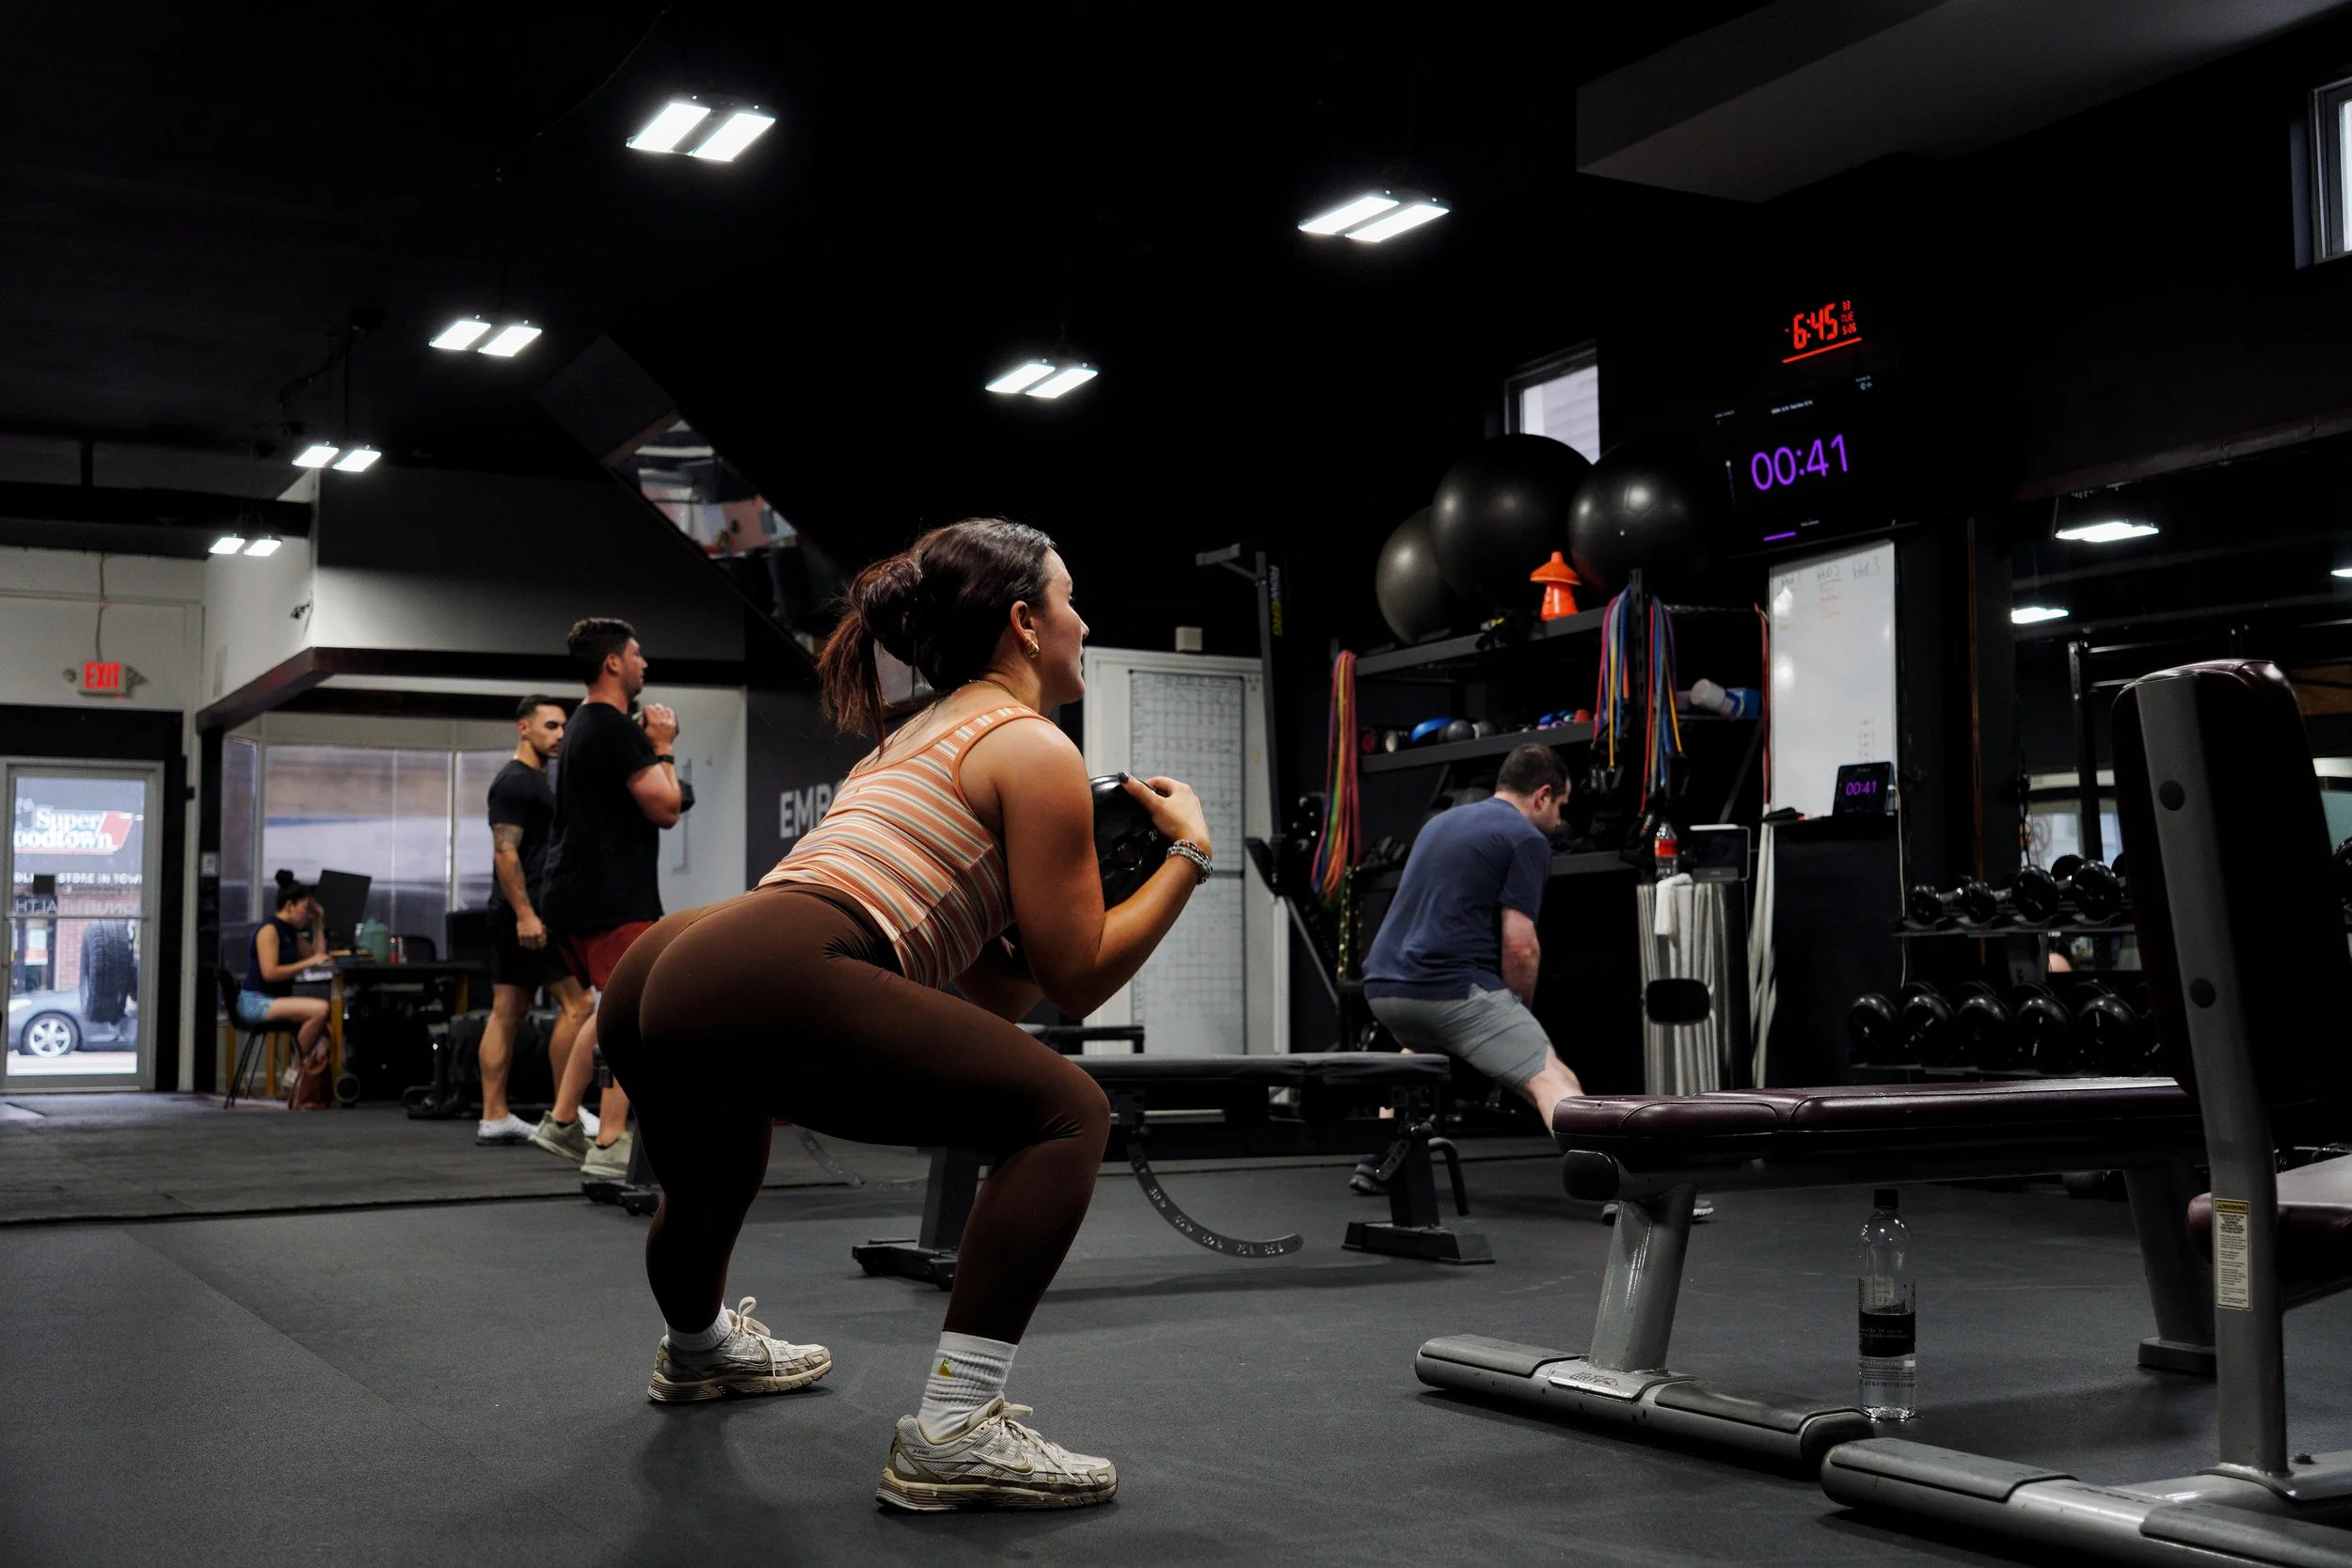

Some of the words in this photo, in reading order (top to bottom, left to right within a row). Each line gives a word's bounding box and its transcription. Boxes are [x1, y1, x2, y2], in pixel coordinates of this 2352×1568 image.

[1793, 303, 1837, 349] 6:45
[1751, 434, 1848, 490] 00:41
[86, 662, 120, 689] EXIT
[1846, 781, 1877, 796] 00:41
[36, 807, 100, 831] Super
[780, 784, 834, 838] EMP
[14, 828, 113, 847] oodtown
[57, 873, 95, 884] STORE
[97, 873, 111, 884] IN
